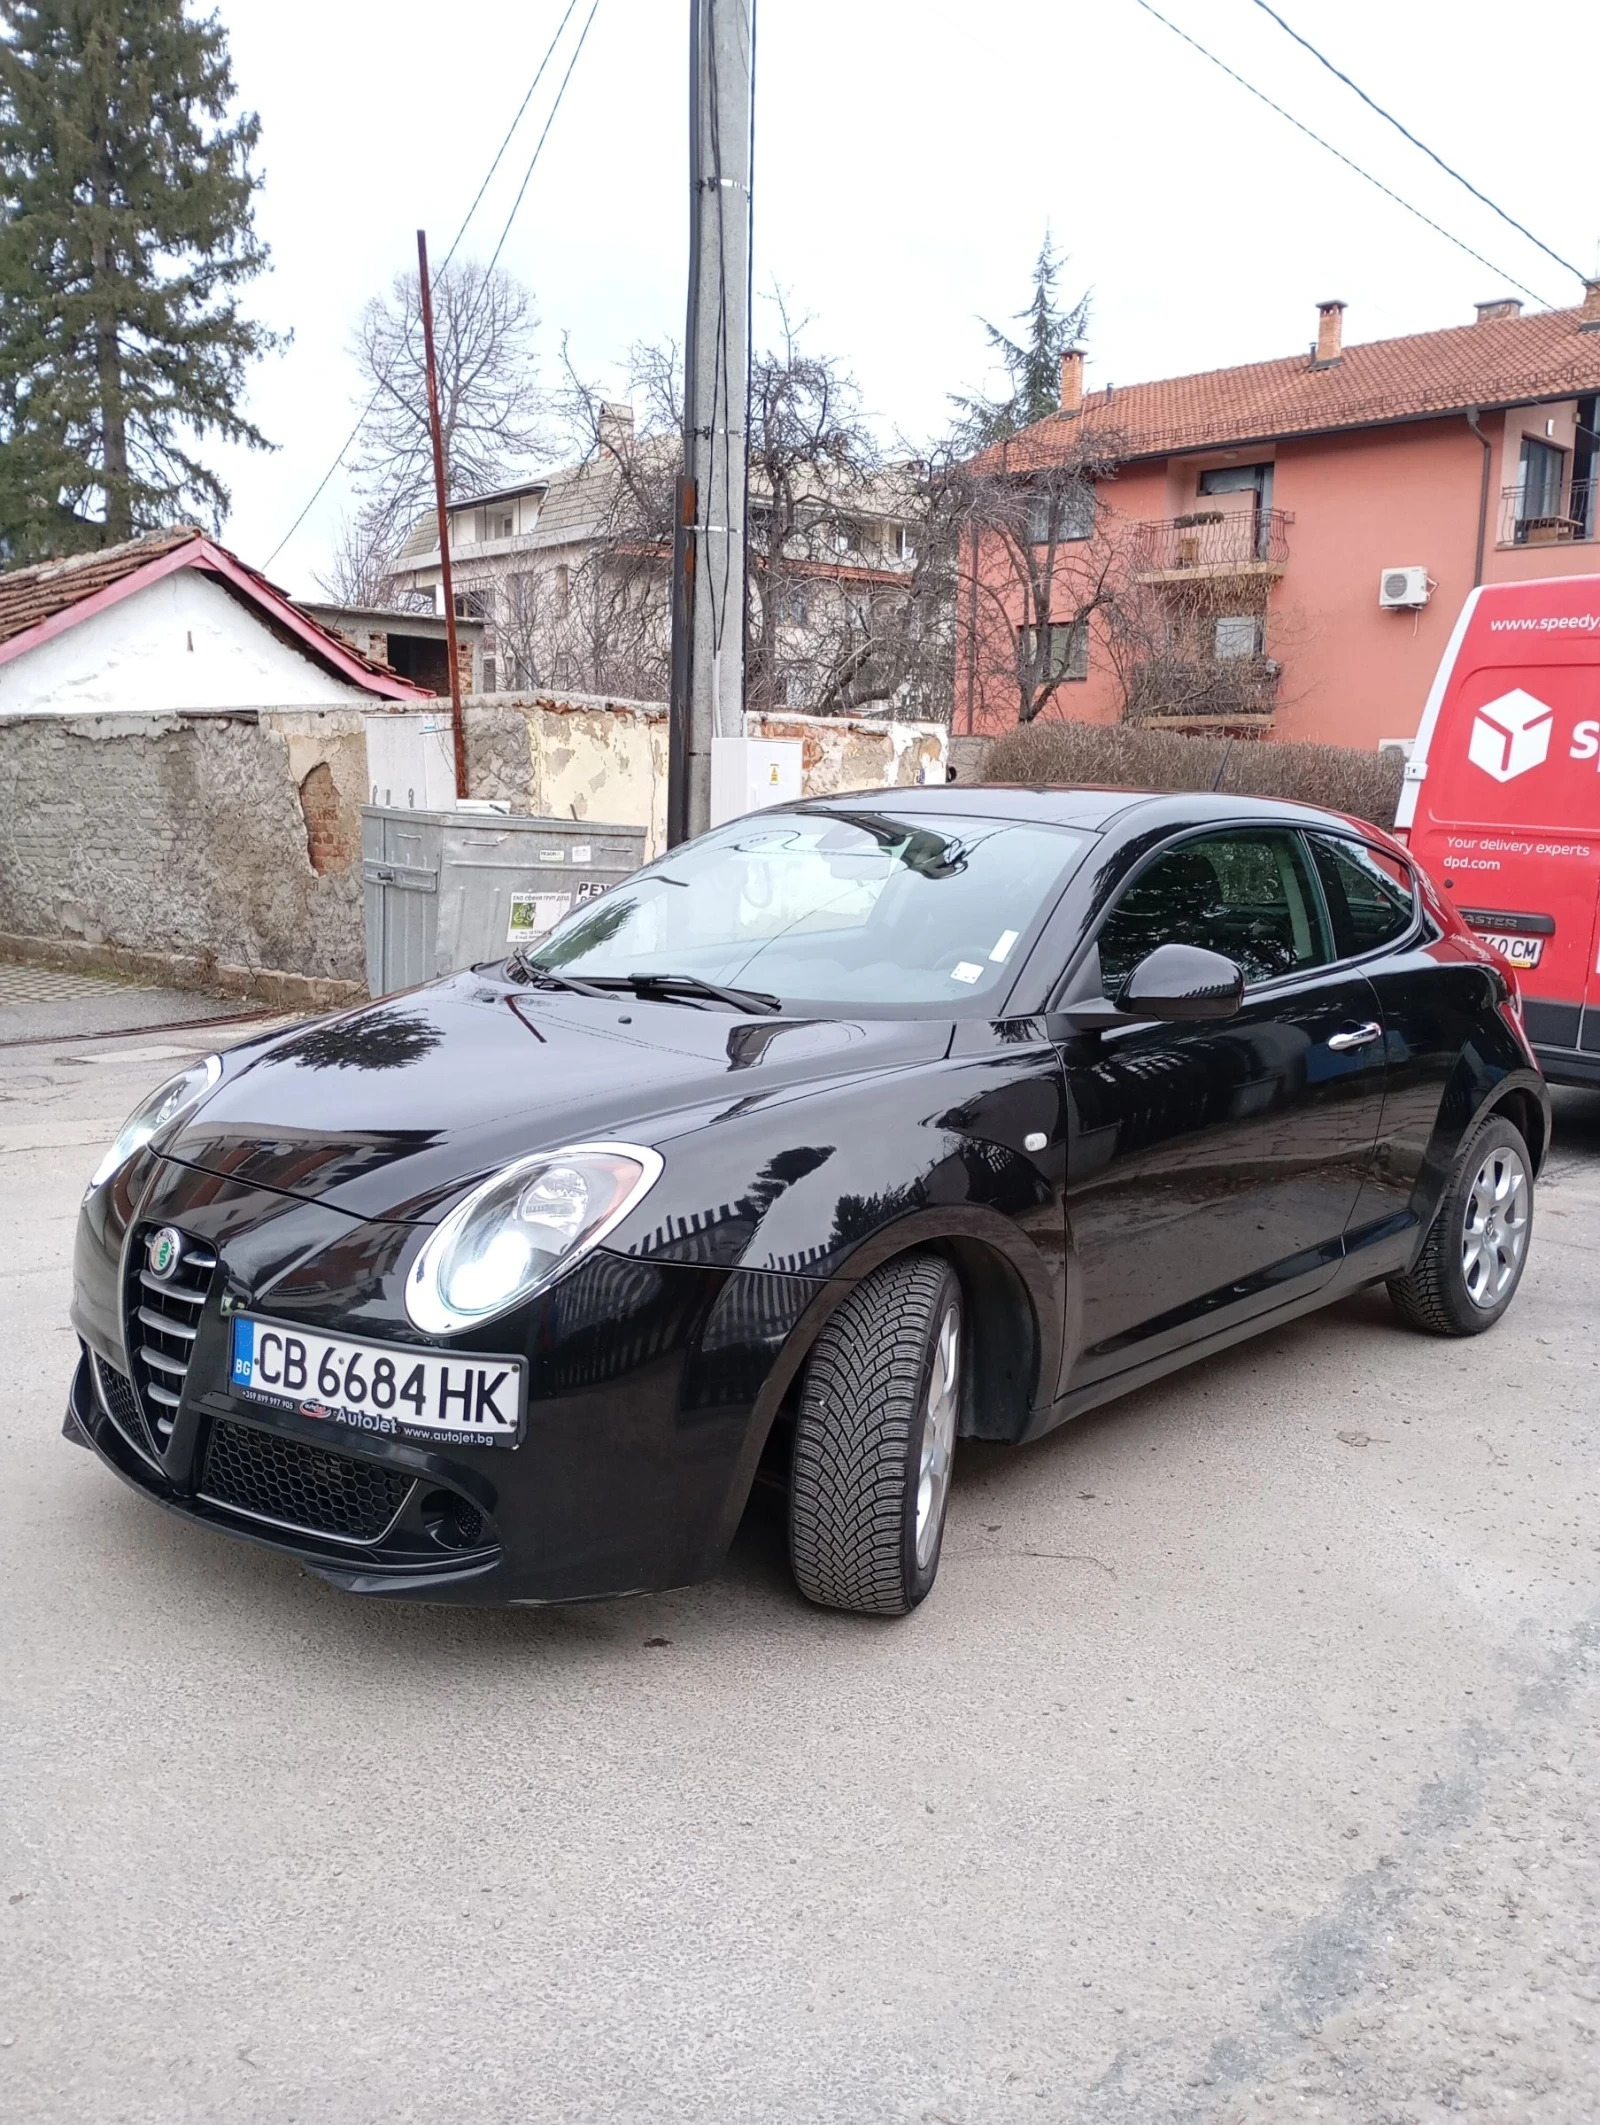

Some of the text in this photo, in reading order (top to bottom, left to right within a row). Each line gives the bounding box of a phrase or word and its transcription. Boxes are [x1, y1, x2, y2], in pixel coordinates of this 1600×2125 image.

[1569, 719, 1600, 773] s
[1447, 836, 1590, 857] Your delivery experts
[1443, 856, 1501, 870] dpd.com
[1463, 914, 1518, 928] ASTER
[235, 1358, 251, 1376] BG
[259, 1333, 509, 1424] CB 6684 HK
[242, 1390, 257, 1400] +359
[281, 1400, 294, 1410] 905
[335, 1407, 398, 1434] AutoJet
[403, 1427, 494, 1446] www.autojet.bg
